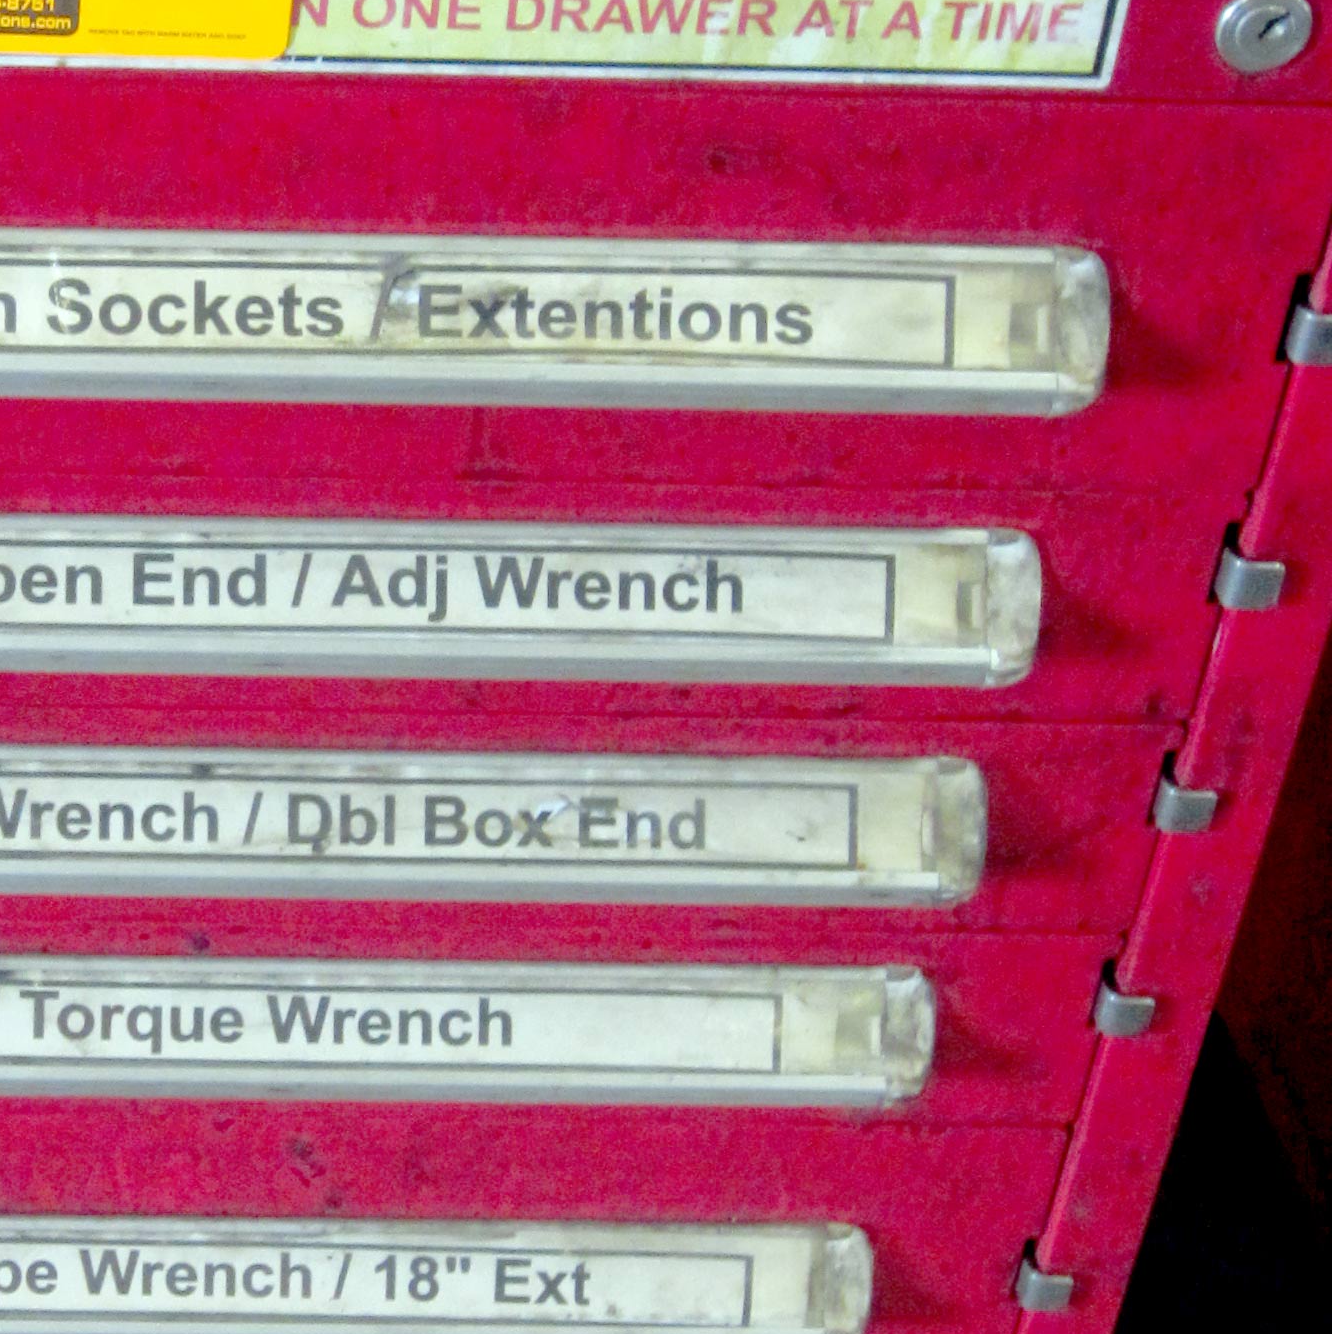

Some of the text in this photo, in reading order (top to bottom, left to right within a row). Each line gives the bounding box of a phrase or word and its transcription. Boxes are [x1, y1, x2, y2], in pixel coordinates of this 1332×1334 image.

[880, 0, 923, 42] A
[944, 0, 1086, 43] TIME
[46, 278, 343, 339] Sockets
[416, 283, 815, 347] Extentions
[132, 550, 268, 608] End
[331, 552, 450, 622] Adj
[475, 552, 743, 613] Wrench
[286, 792, 396, 849] Dbl
[421, 794, 553, 850] Box
[578, 796, 706, 852] End
[19, 989, 244, 1054] Torque
[269, 993, 513, 1047] Wrench
[80, 1248, 313, 1300] Wrench
[373, 1253, 473, 1302] 18"
[495, 1257, 590, 1307] Ext
